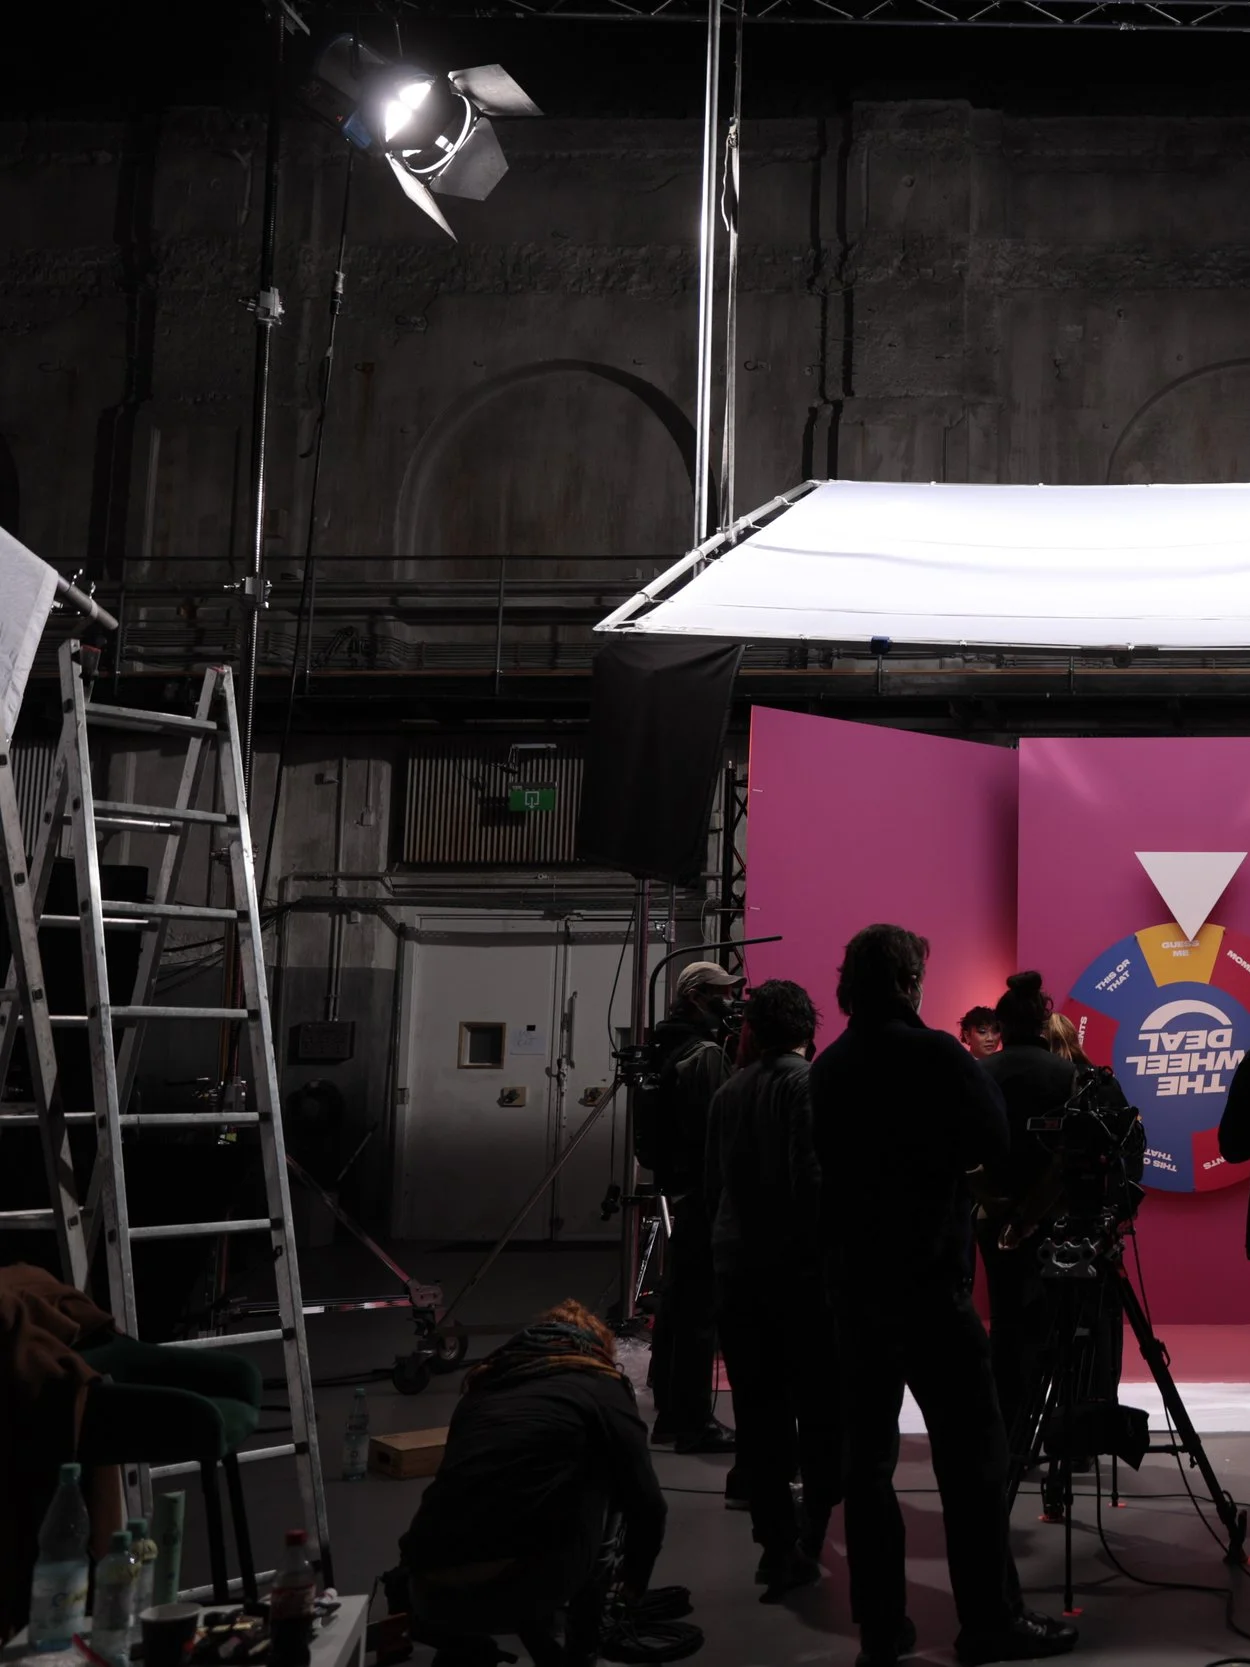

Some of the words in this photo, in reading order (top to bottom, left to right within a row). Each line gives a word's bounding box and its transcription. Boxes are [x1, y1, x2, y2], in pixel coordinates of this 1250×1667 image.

[1161, 940, 1200, 949] GUESS
[1095, 971, 1117, 991] THIS
[1115, 958, 1132, 974] OR
[1107, 970, 1130, 992] THAT
[1138, 1028, 1233, 1052] DEAL
[1125, 1049, 1245, 1075] WHEEL
[1156, 1073, 1226, 1096] THE
[1143, 1148, 1173, 1161] THAT
[1152, 1159, 1177, 1172] THIS
